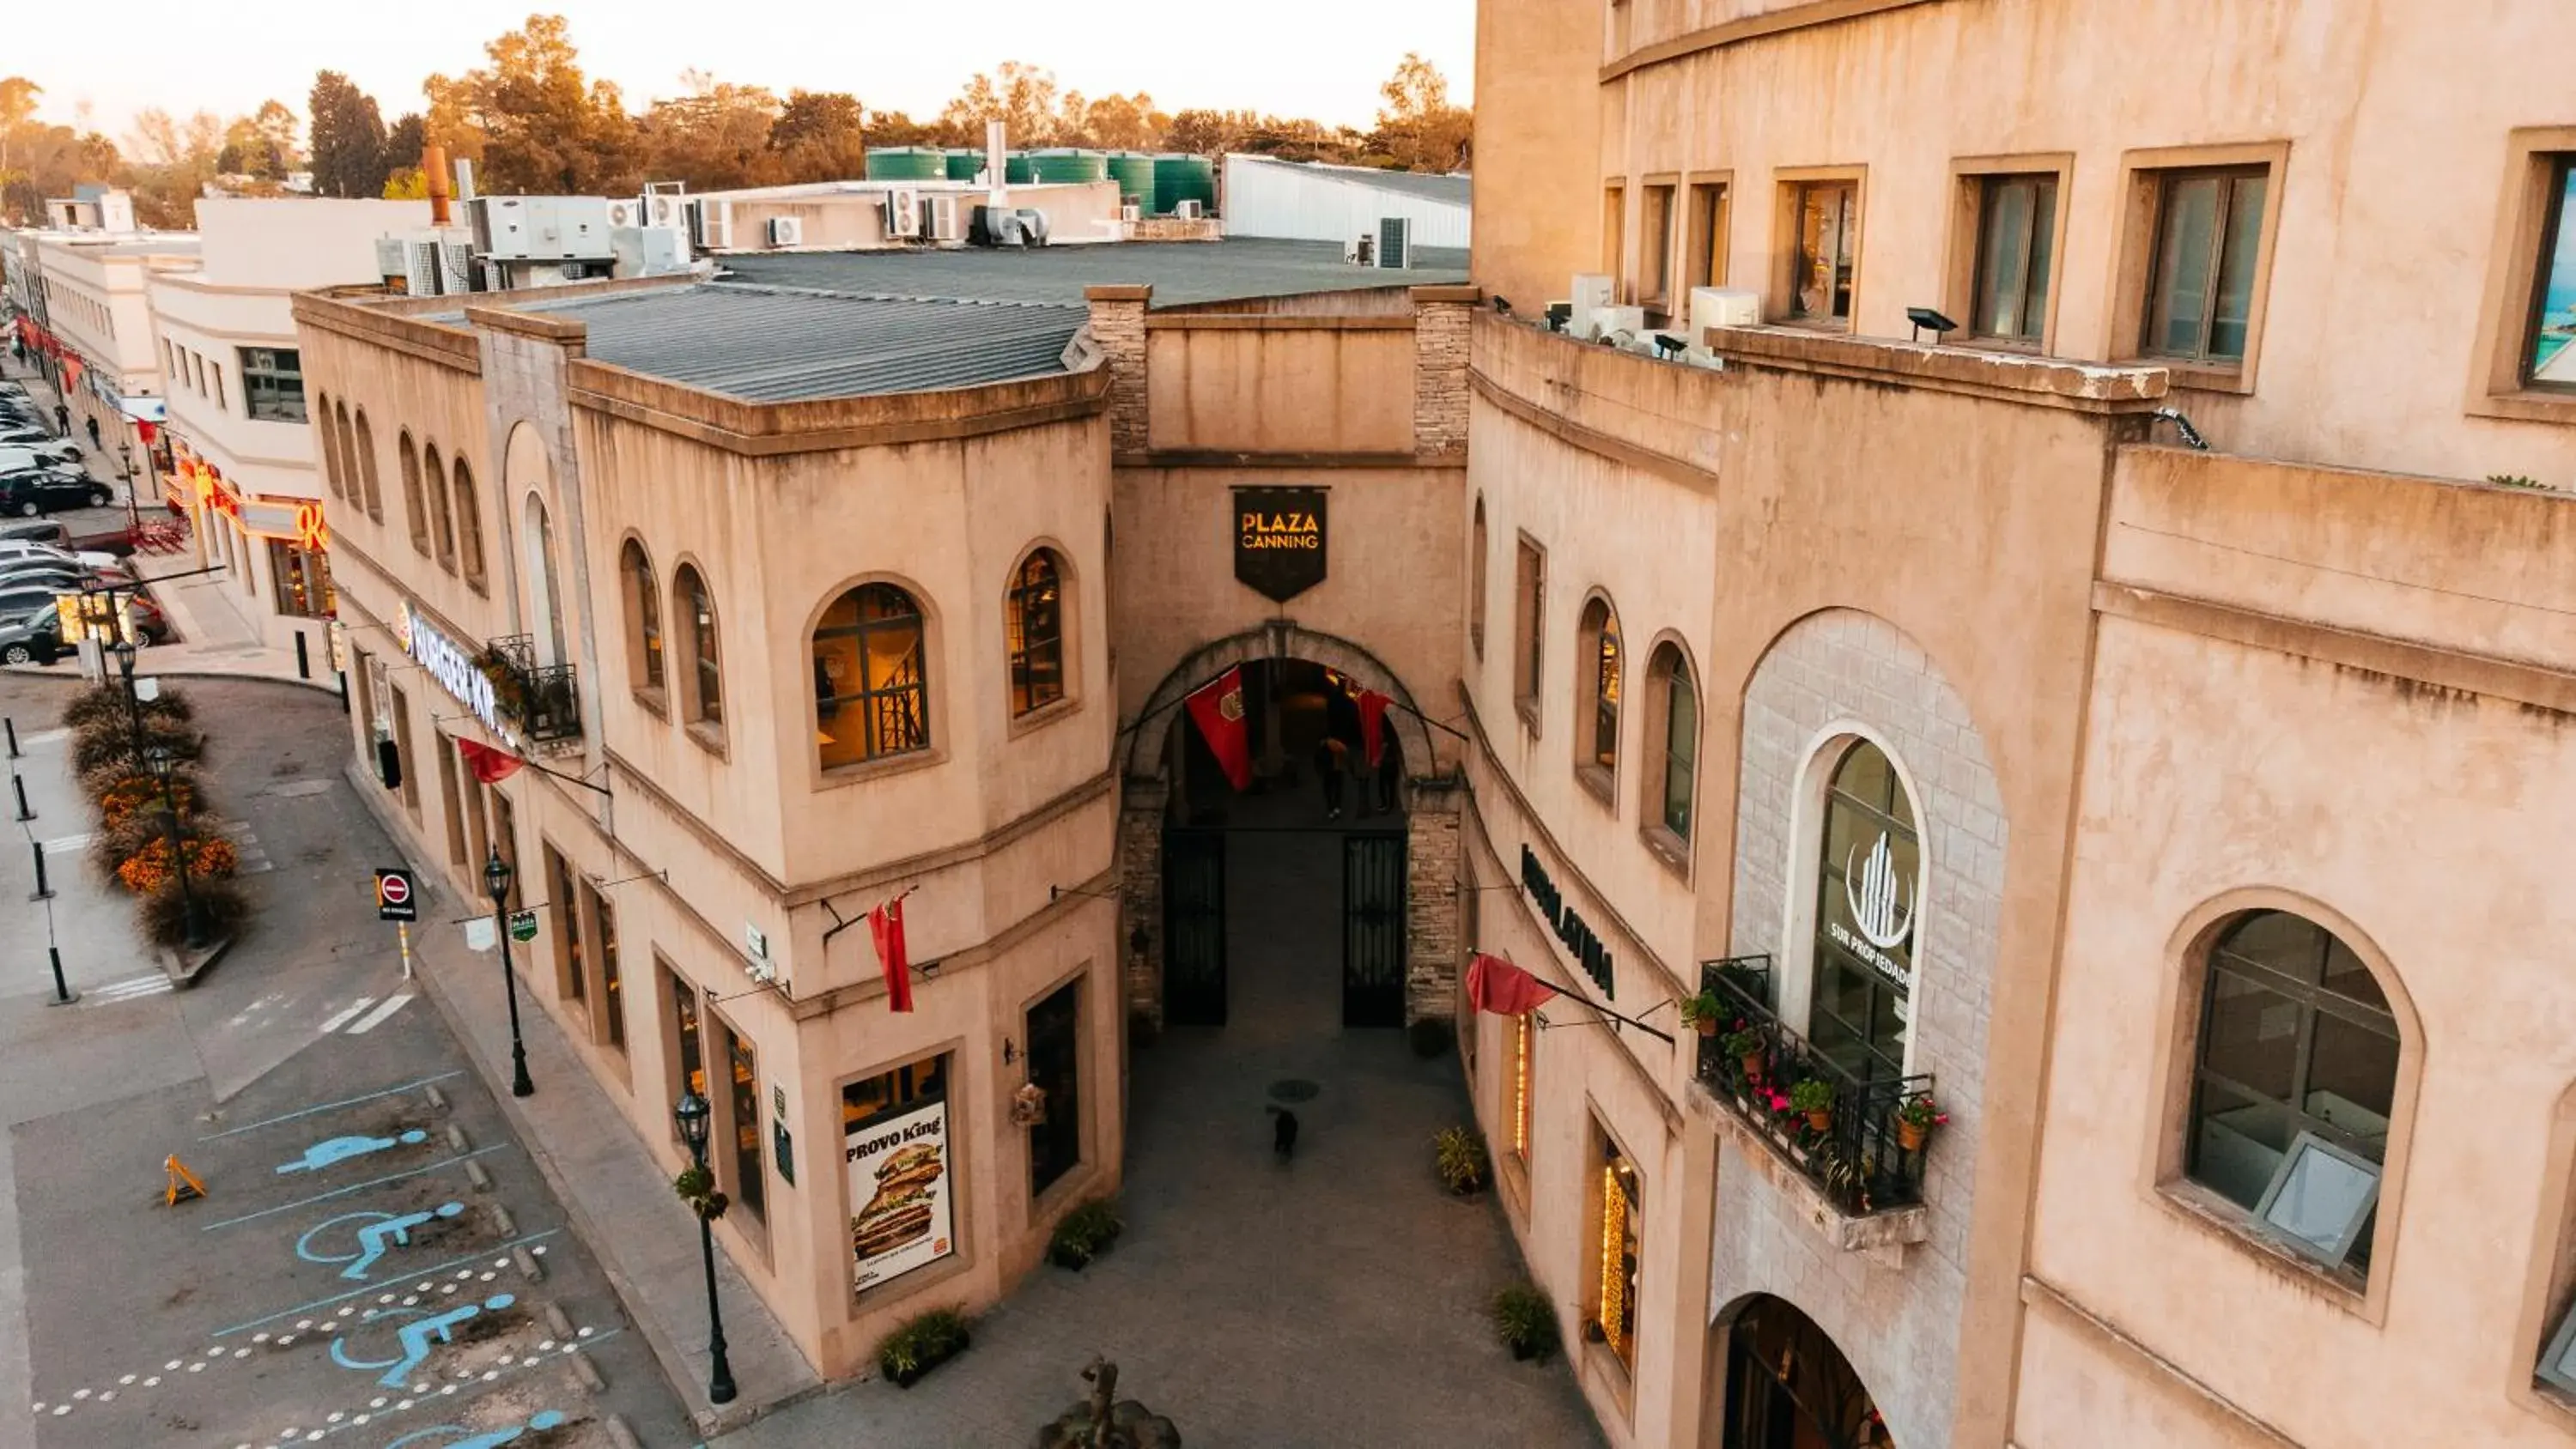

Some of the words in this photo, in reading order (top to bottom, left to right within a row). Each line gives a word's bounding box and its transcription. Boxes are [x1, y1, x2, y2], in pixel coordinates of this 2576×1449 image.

[1242, 513, 1318, 532] PLAZA
[1242, 535, 1319, 549] CANNING
[1830, 922, 1850, 946] SUR
[847, 1131, 900, 1163] PROVO
[902, 1116, 942, 1143] King
